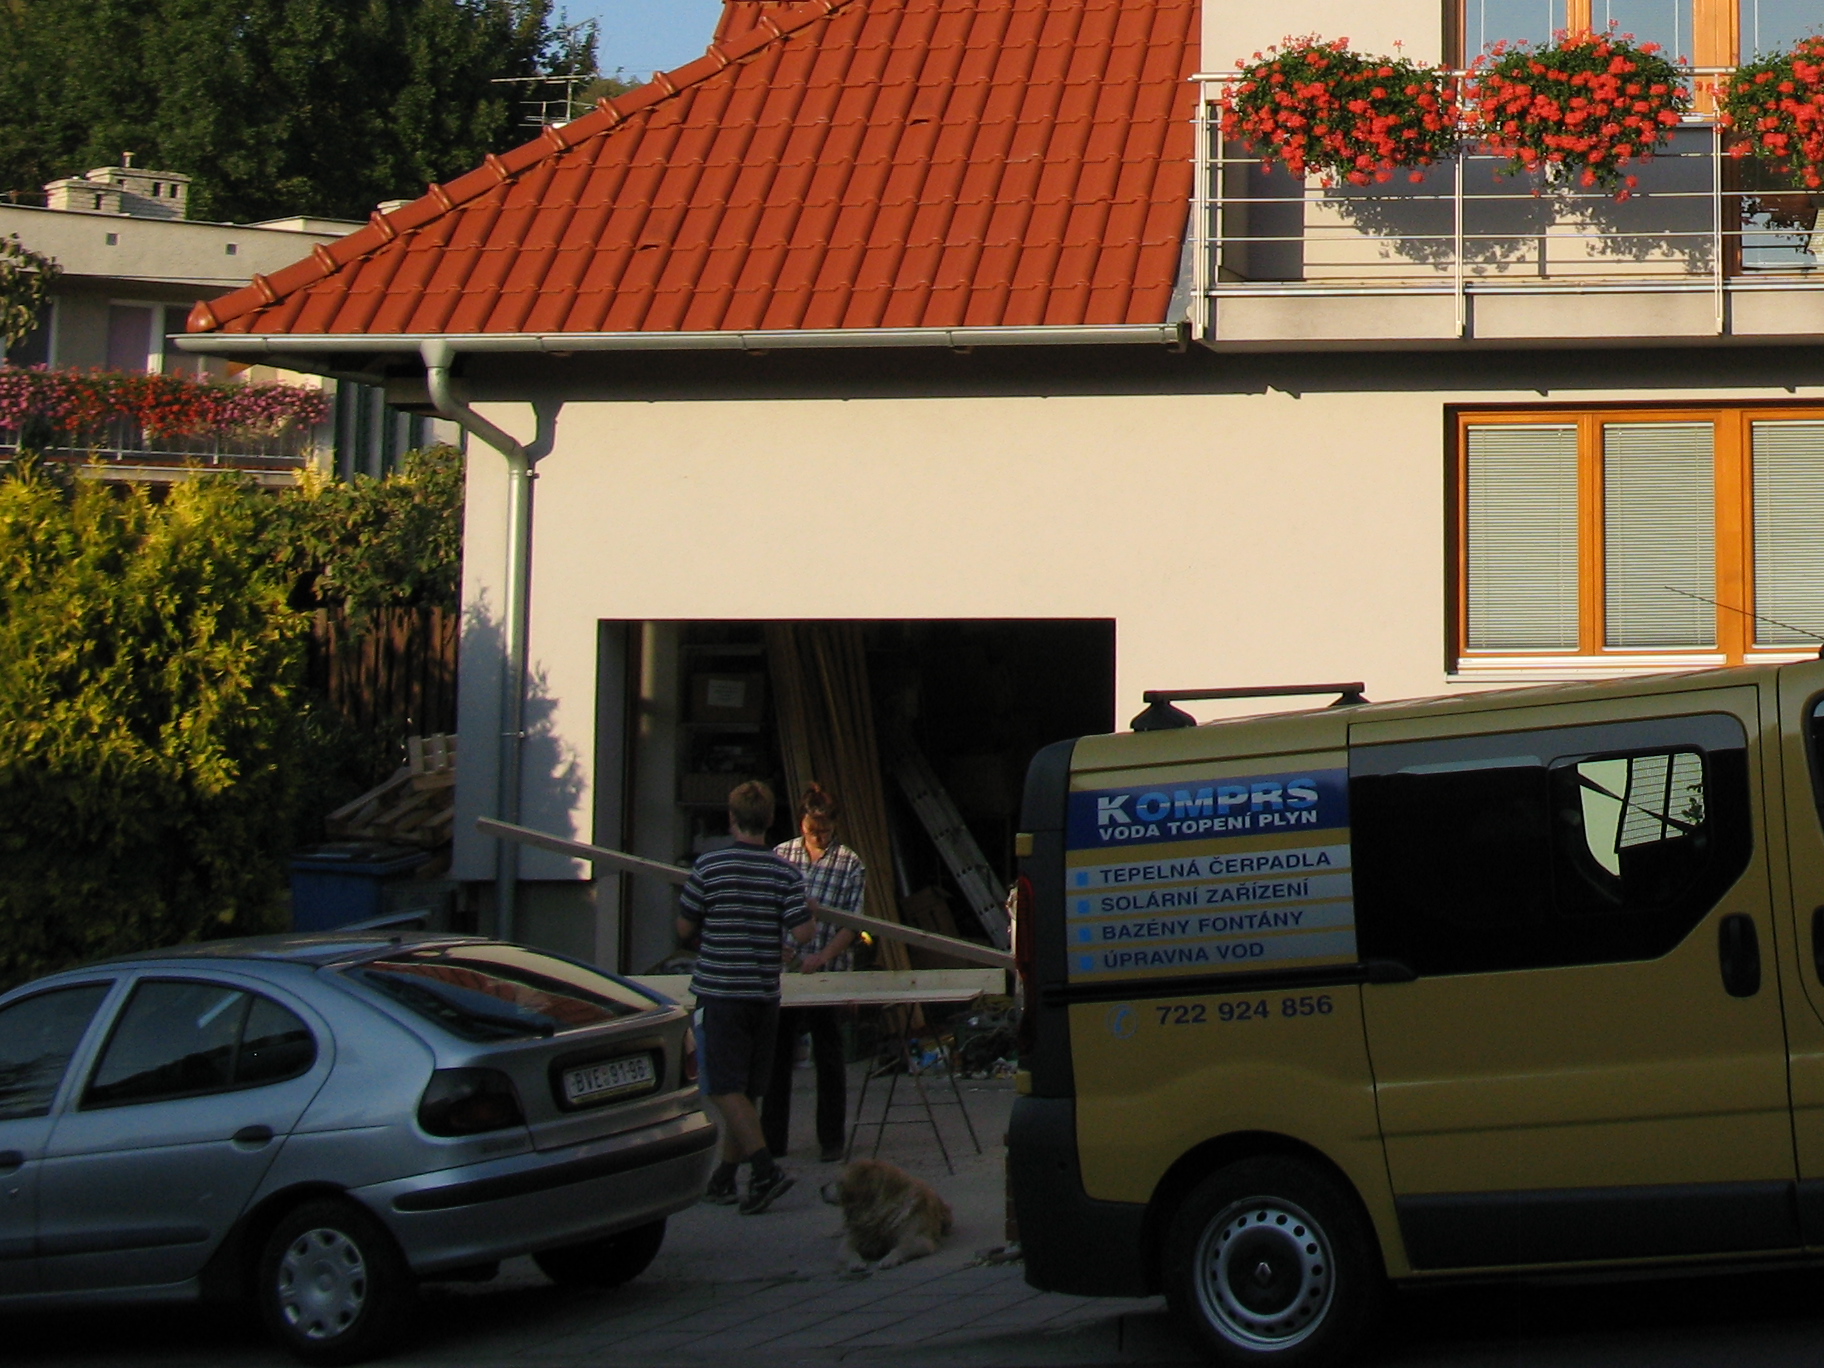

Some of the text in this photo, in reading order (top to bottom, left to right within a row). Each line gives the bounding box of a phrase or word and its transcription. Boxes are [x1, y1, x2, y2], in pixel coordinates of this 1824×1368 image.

[1098, 778, 1319, 825] KOMPRS
[1099, 810, 1318, 841] VODA TOPENÍ PLYN
[1100, 851, 1331, 885] TEPELNÁ ČERPADLA
[1101, 878, 1309, 913] SOLÁRNÍ ZAŘÍZENÍ
[1103, 910, 1303, 941] BAZÉNY FONTÁNY
[1104, 942, 1264, 969] ÚPRAVNA VOD
[1156, 995, 1333, 1025] 722 924 856
